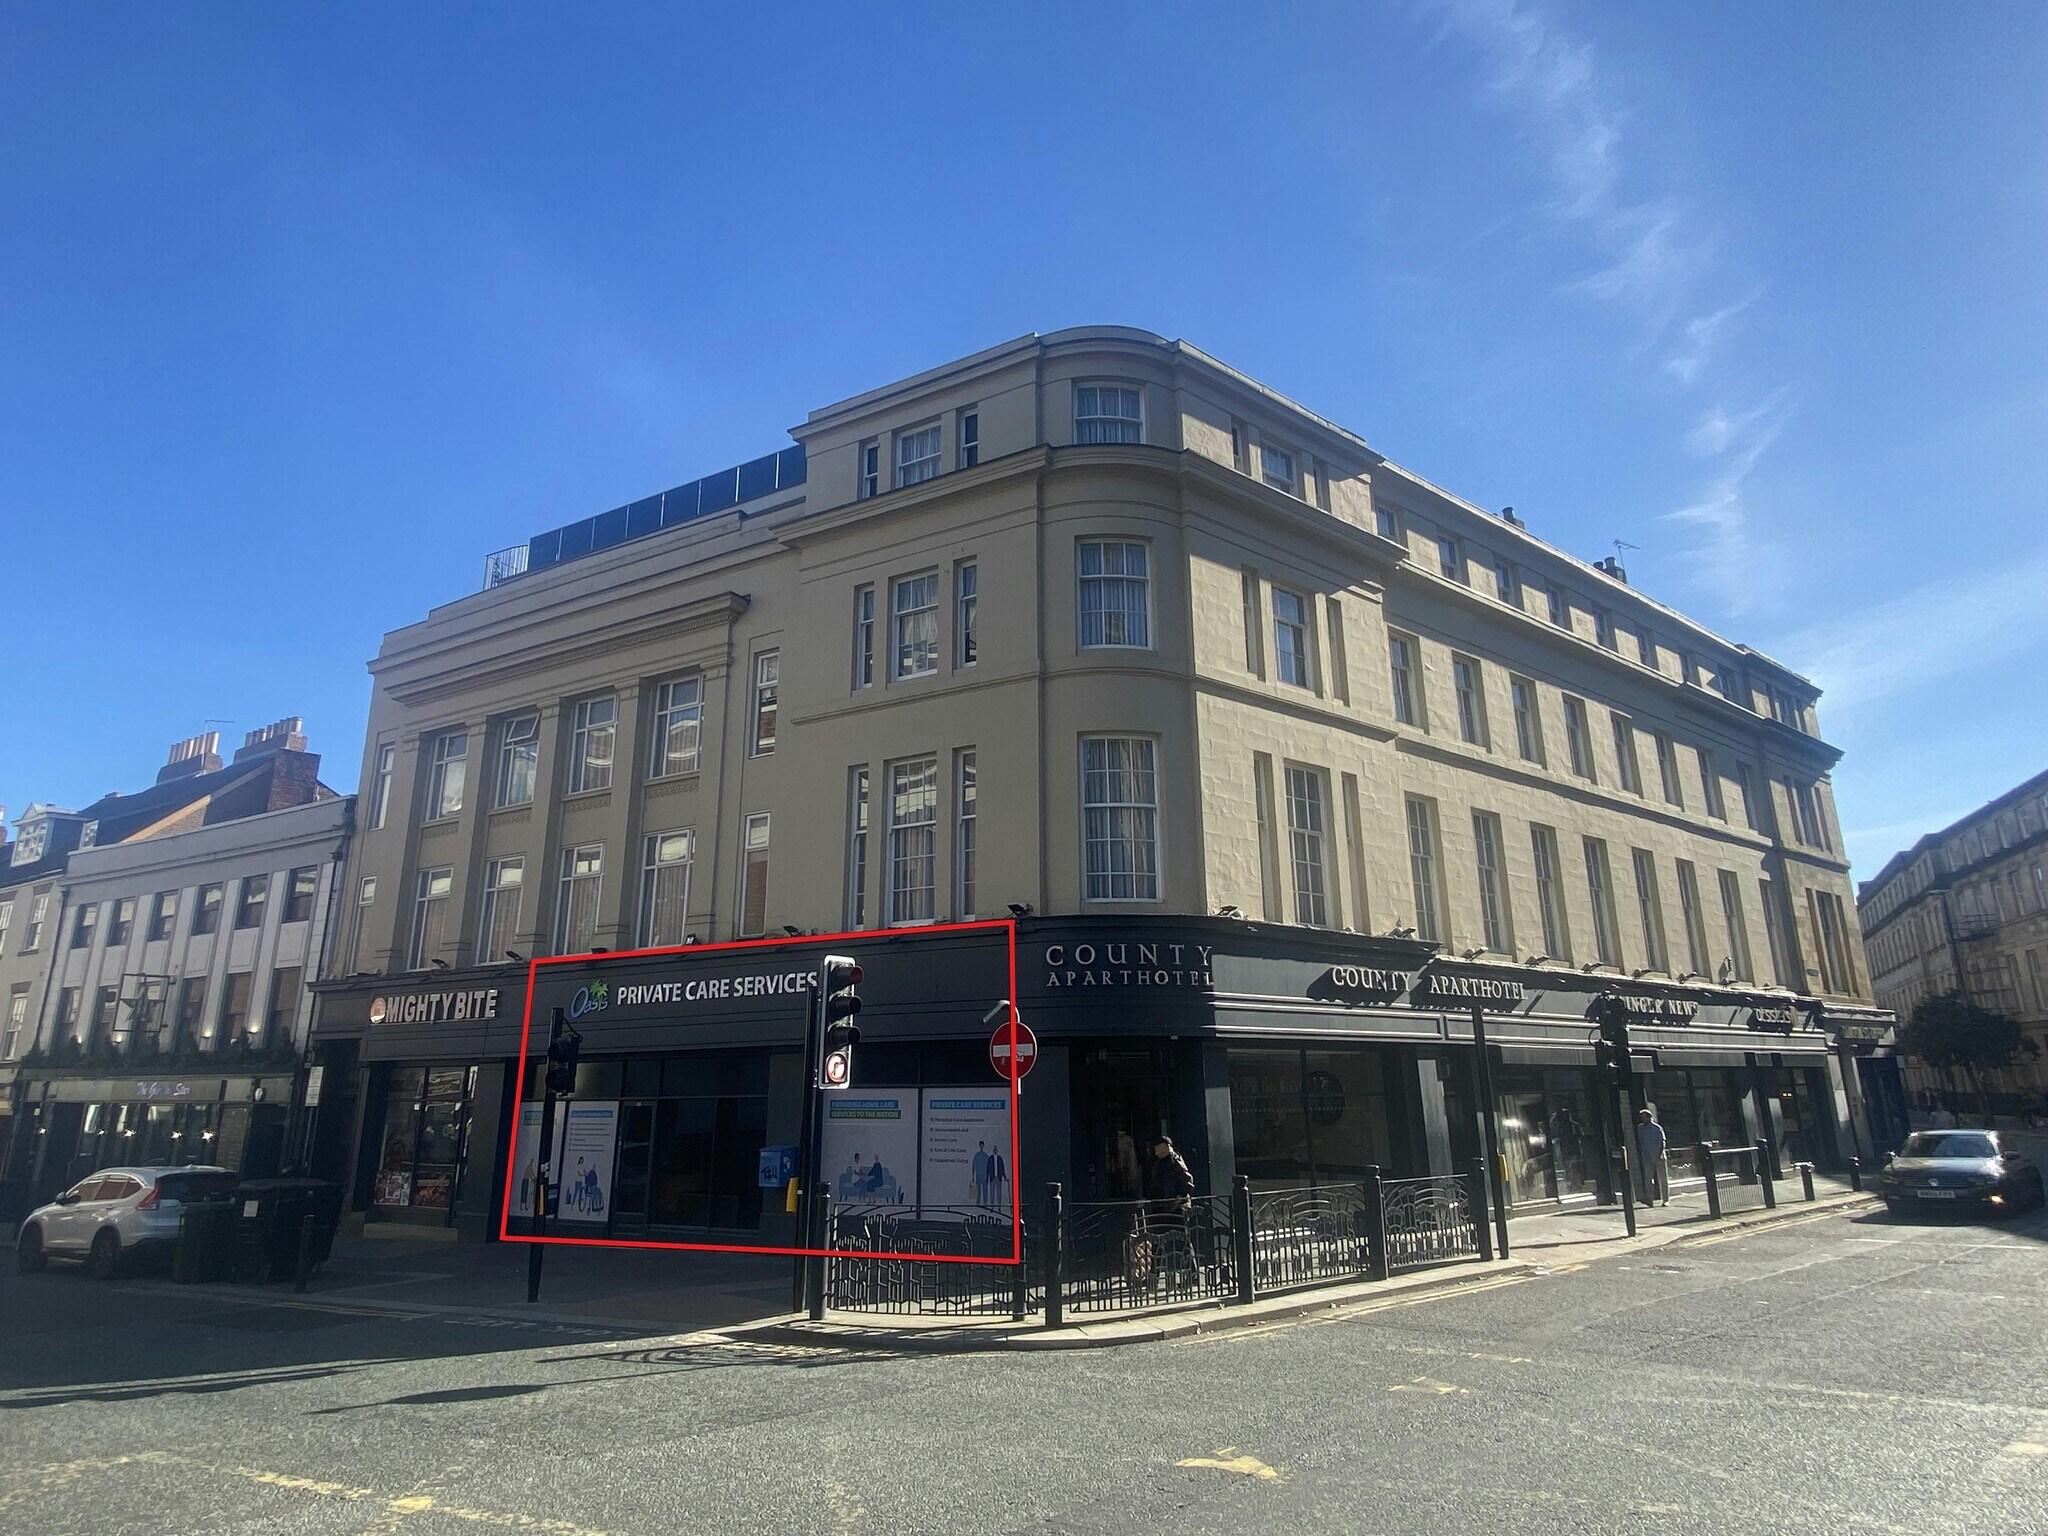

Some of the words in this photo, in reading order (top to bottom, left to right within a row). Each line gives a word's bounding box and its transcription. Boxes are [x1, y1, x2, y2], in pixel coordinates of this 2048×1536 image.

[1045, 943, 1213, 966] COUNTY
[617, 982, 682, 1005] PRIVATE
[685, 978, 730, 1001] CARE
[733, 971, 818, 997] SERVICES
[1046, 970, 1214, 987] APARTHOTEL
[1332, 965, 1411, 993] COUNTY
[1429, 974, 1528, 1000] APARTHOTEL
[570, 986, 609, 1018] Oasis
